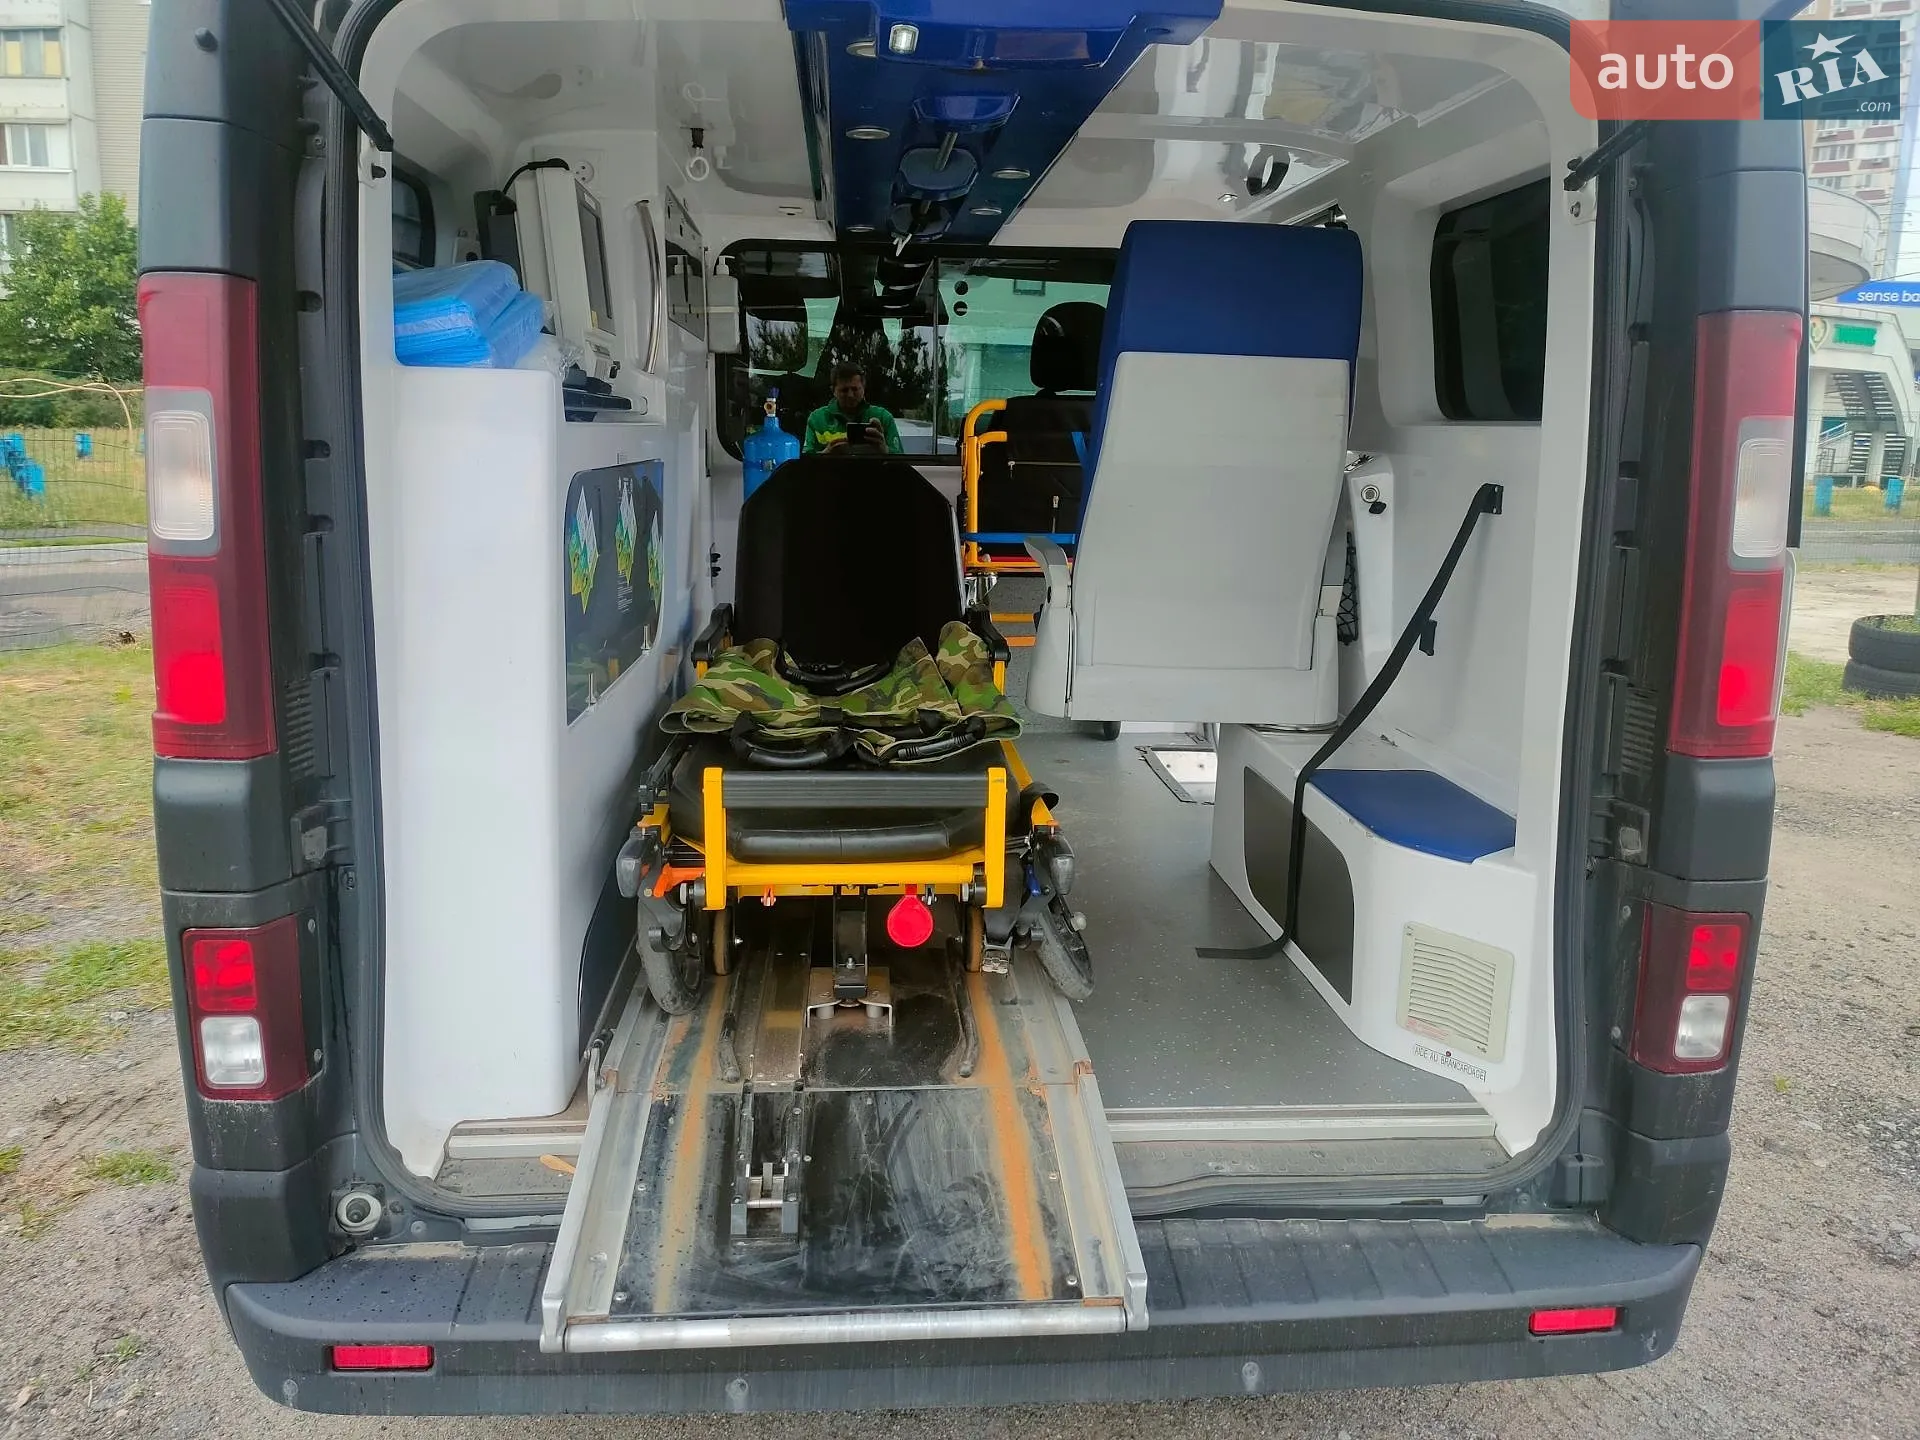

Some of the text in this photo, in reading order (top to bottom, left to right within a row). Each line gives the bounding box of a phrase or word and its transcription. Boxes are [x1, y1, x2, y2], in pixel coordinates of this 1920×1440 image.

[1856, 291, 1899, 302] sense
[1414, 1046, 1428, 1059] AIDE
[1430, 1051, 1439, 1063] AU
